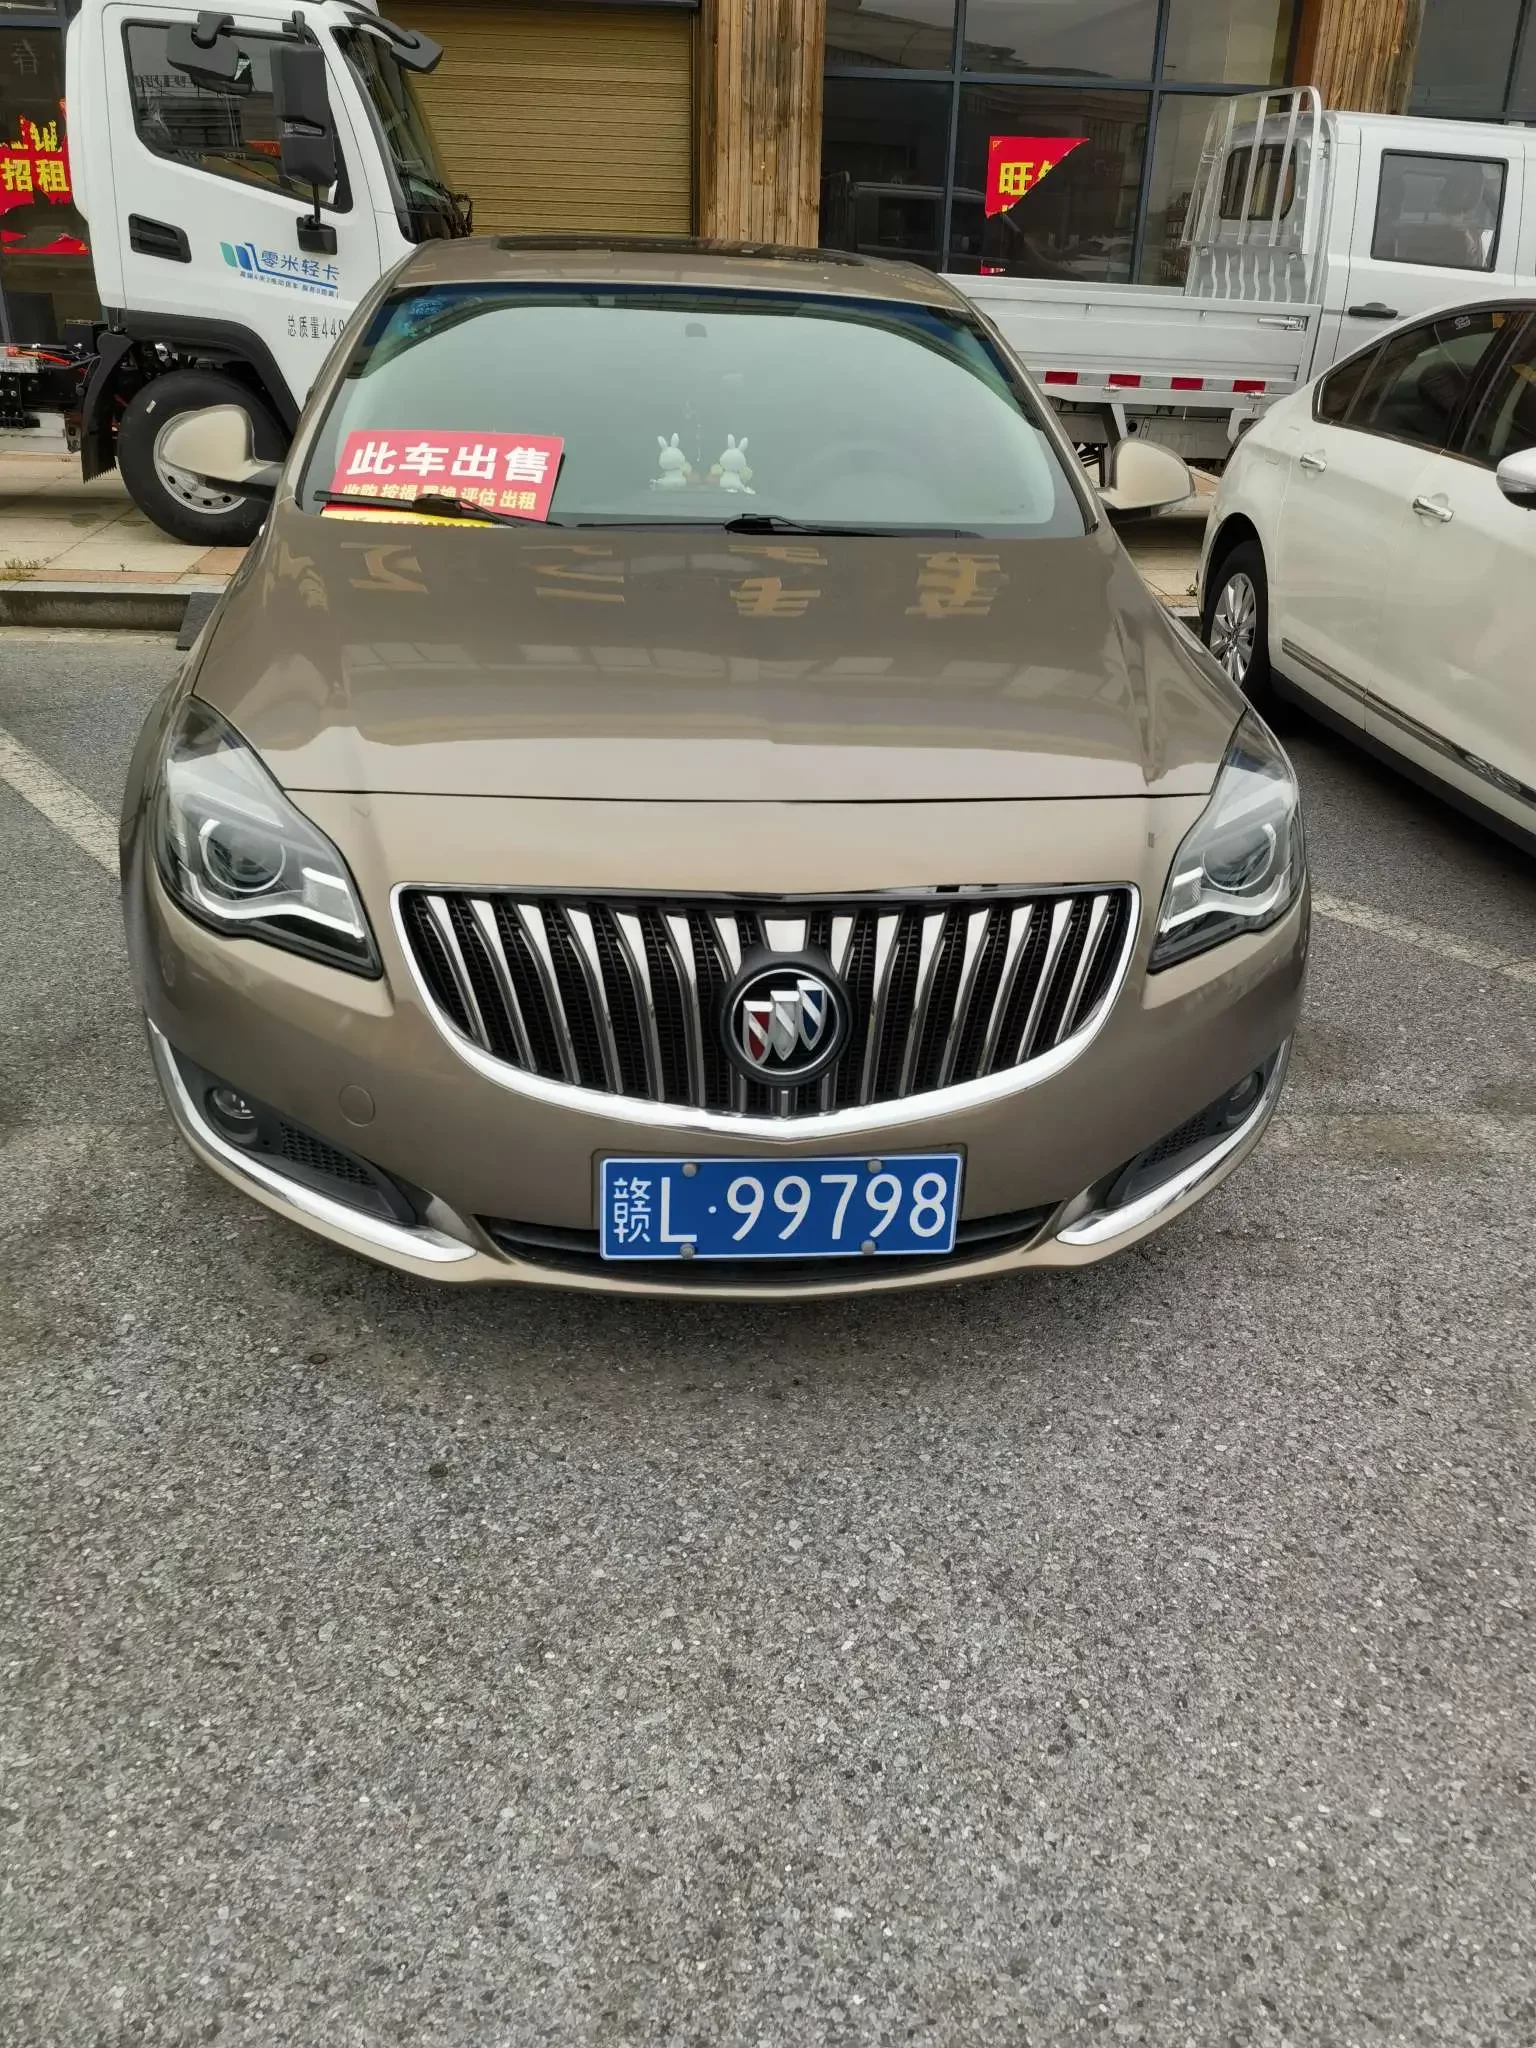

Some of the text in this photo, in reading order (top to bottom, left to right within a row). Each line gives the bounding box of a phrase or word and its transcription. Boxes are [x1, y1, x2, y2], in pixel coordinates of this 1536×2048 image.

[1, 157, 70, 192] 招租
[261, 250, 340, 280] 零米轻卡
[347, 441, 549, 484] 此车出售
[460, 487, 497, 507] 评估
[499, 491, 537, 511] 出租
